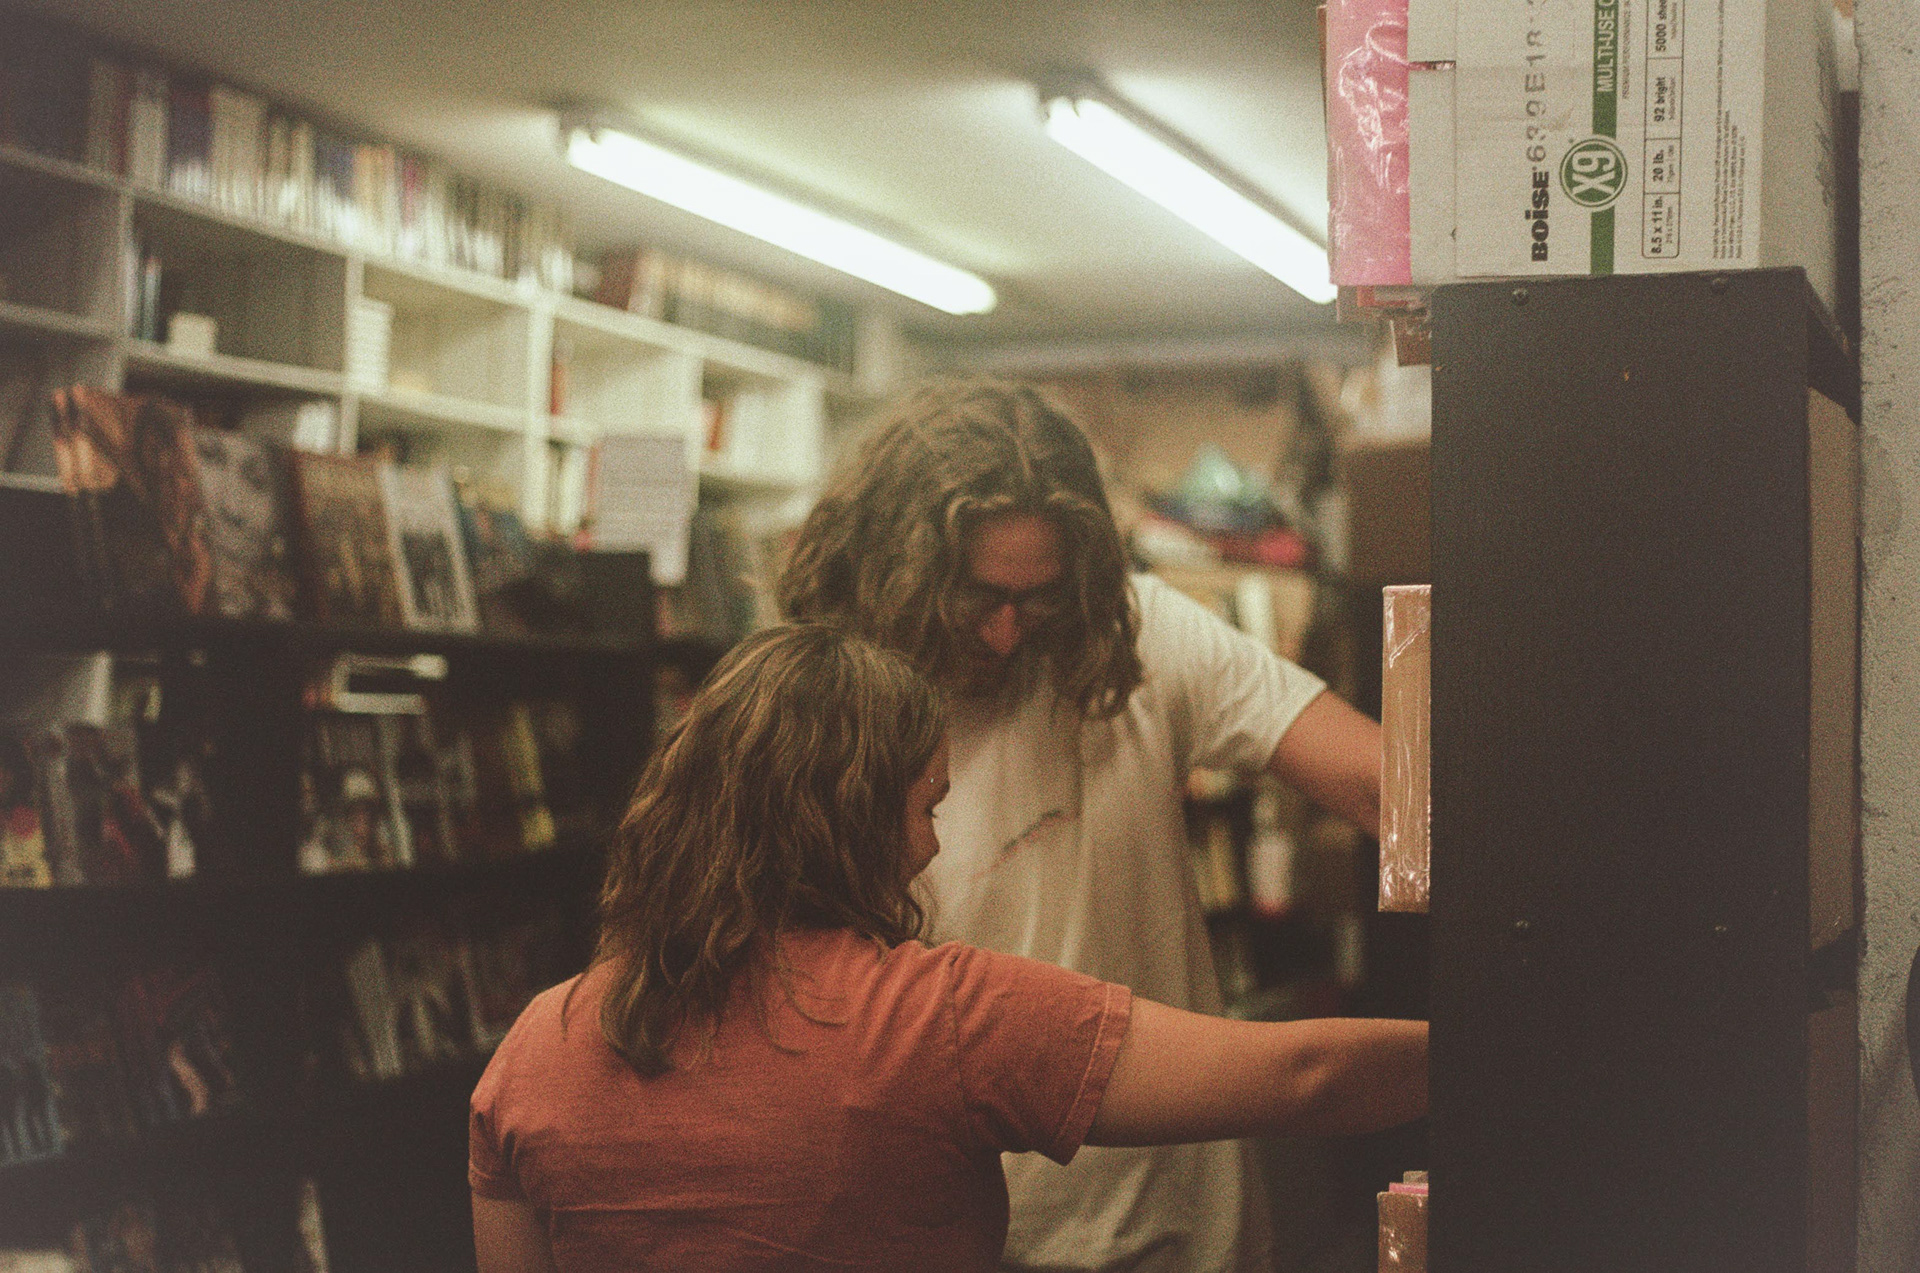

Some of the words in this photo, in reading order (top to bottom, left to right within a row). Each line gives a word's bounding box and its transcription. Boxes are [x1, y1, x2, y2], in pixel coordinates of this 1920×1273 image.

[1656, 23, 1667, 52] 5000
[1597, 9, 1615, 93] MULTI-USE
[1654, 76, 1668, 104] bright
[1654, 107, 1665, 122] 92
[1653, 149, 1664, 164] lb.
[1571, 150, 1616, 195] X9
[1652, 167, 1664, 182] 20
[1652, 195, 1663, 209] in.
[1651, 210, 1662, 223] 11
[1651, 237, 1662, 255] 8.5
